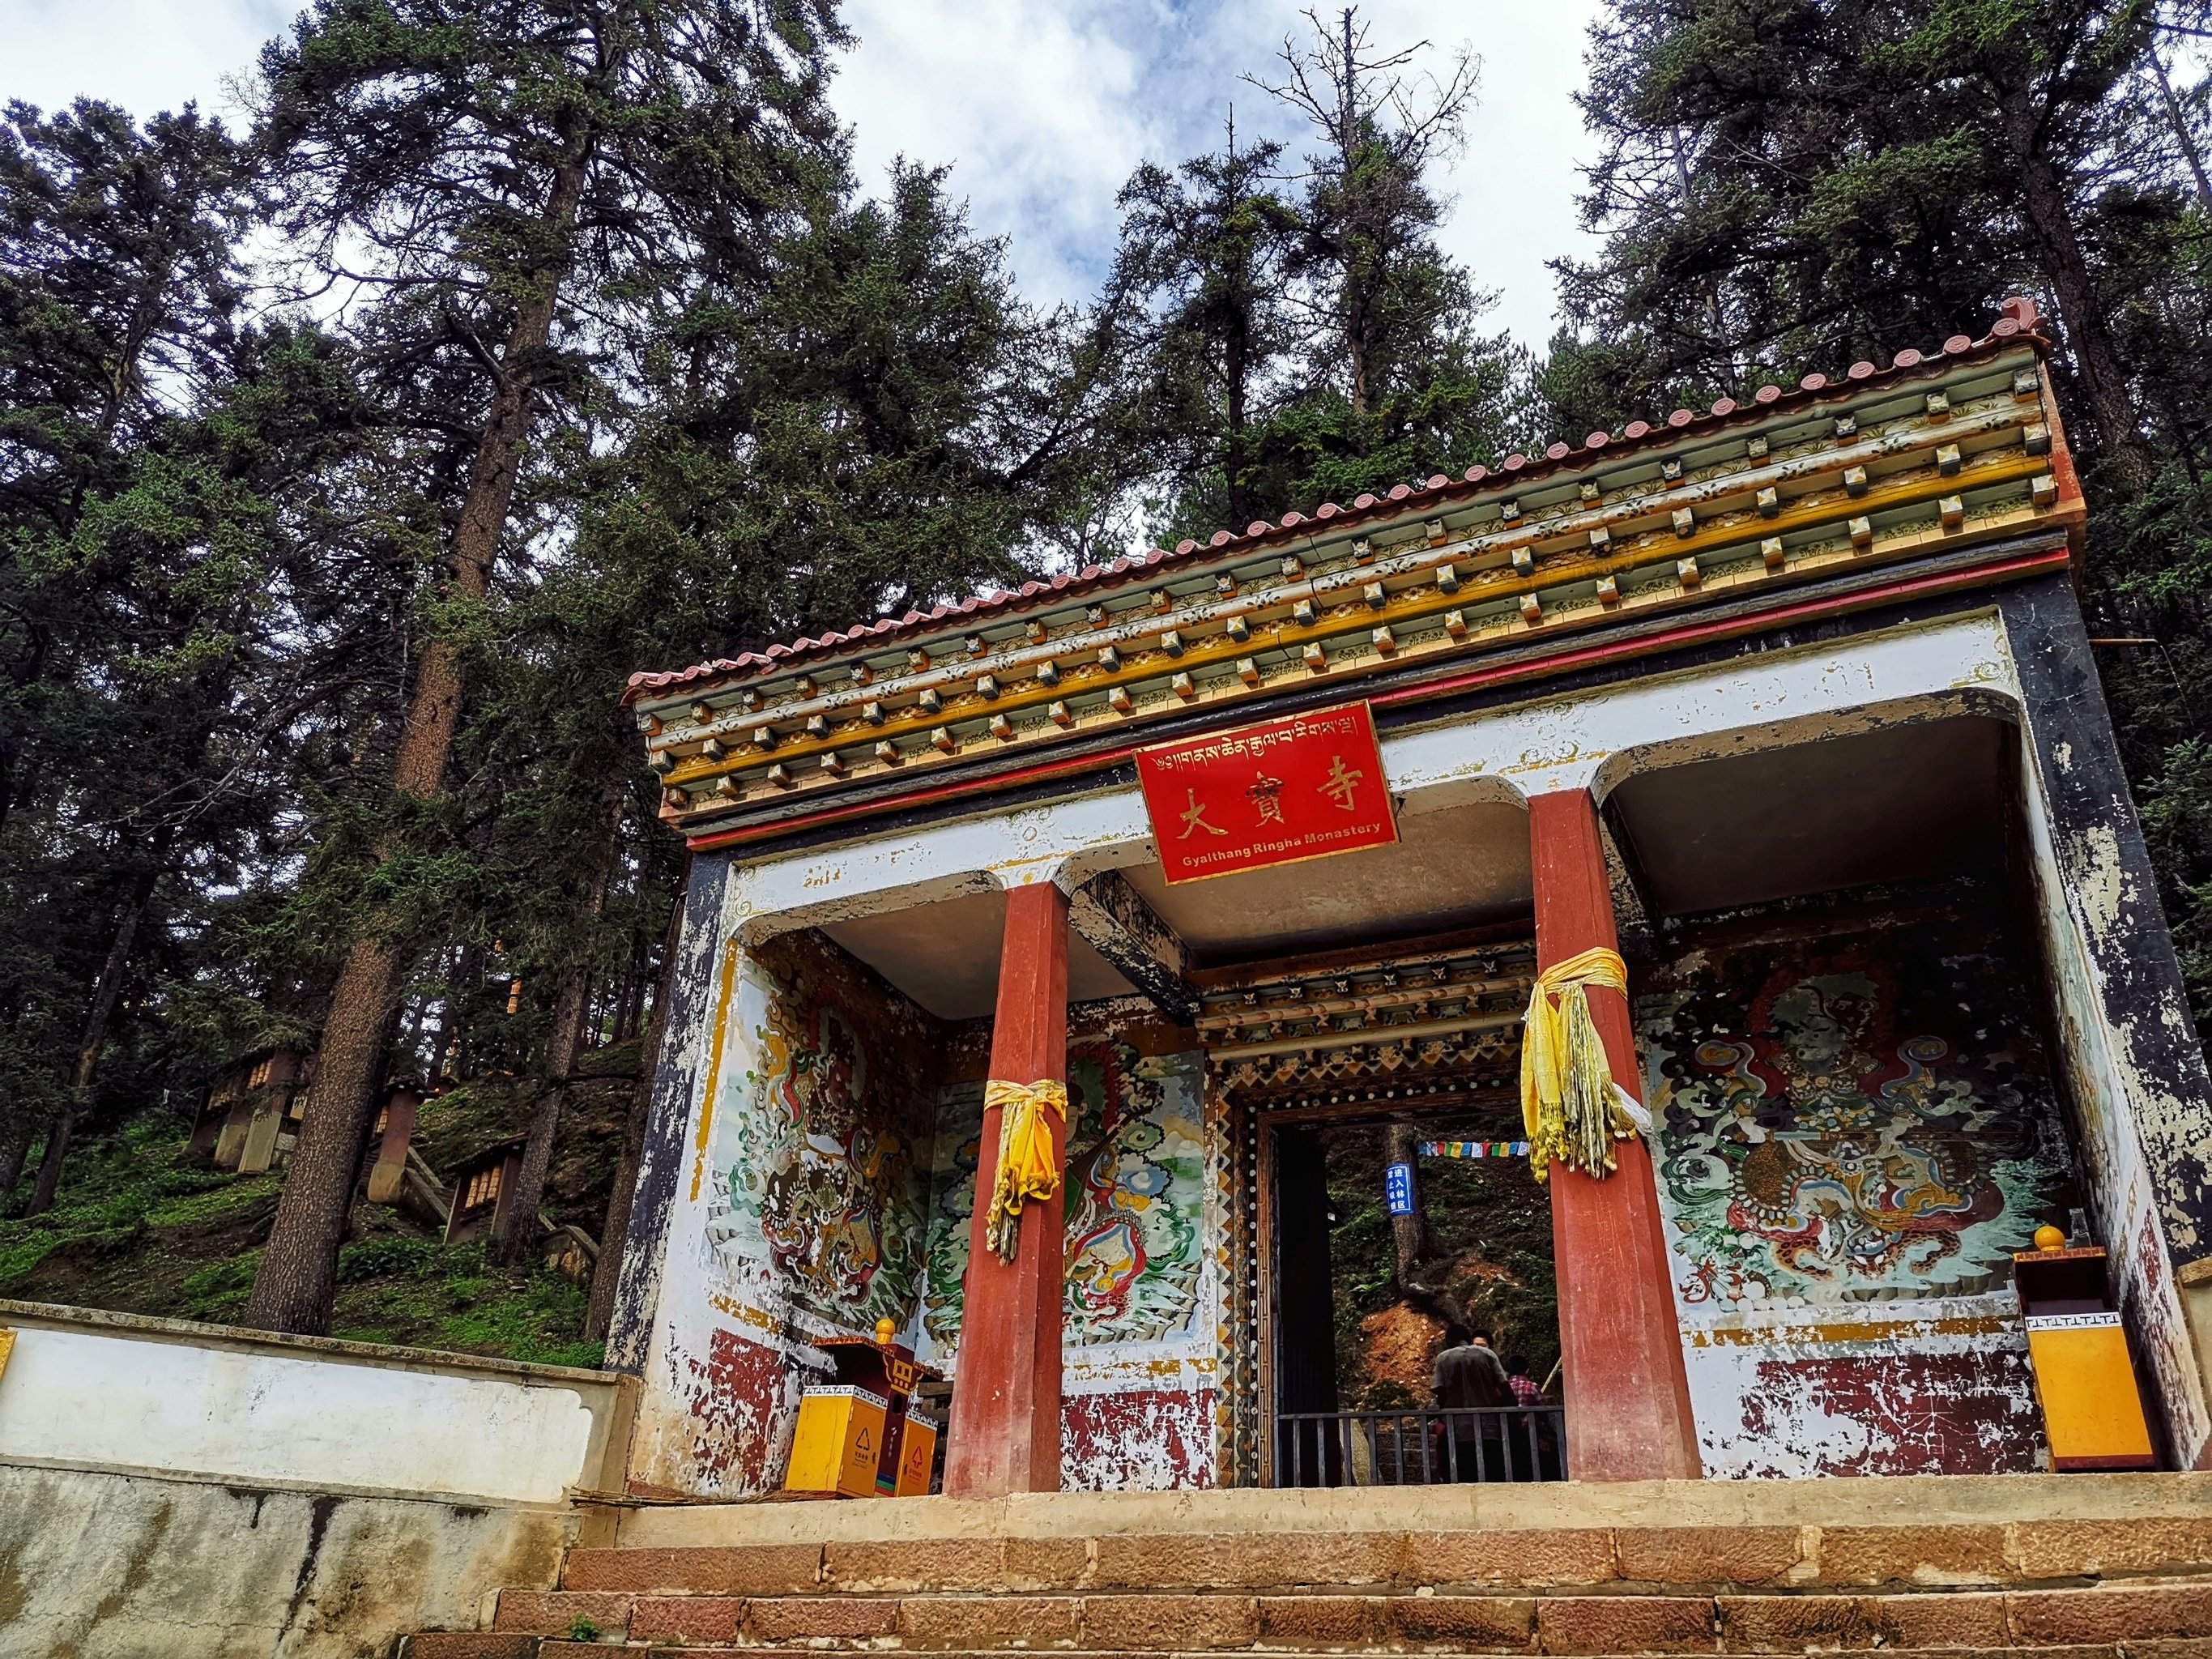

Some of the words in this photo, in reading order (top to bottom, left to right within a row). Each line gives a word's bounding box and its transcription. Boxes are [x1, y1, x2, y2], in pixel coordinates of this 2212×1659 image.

[1183, 848, 1252, 867] Gyalthang
[1253, 838, 1302, 855] Ringha
[1303, 822, 1381, 845] Monastery
[1394, 1169, 1405, 1209] 进入林区
